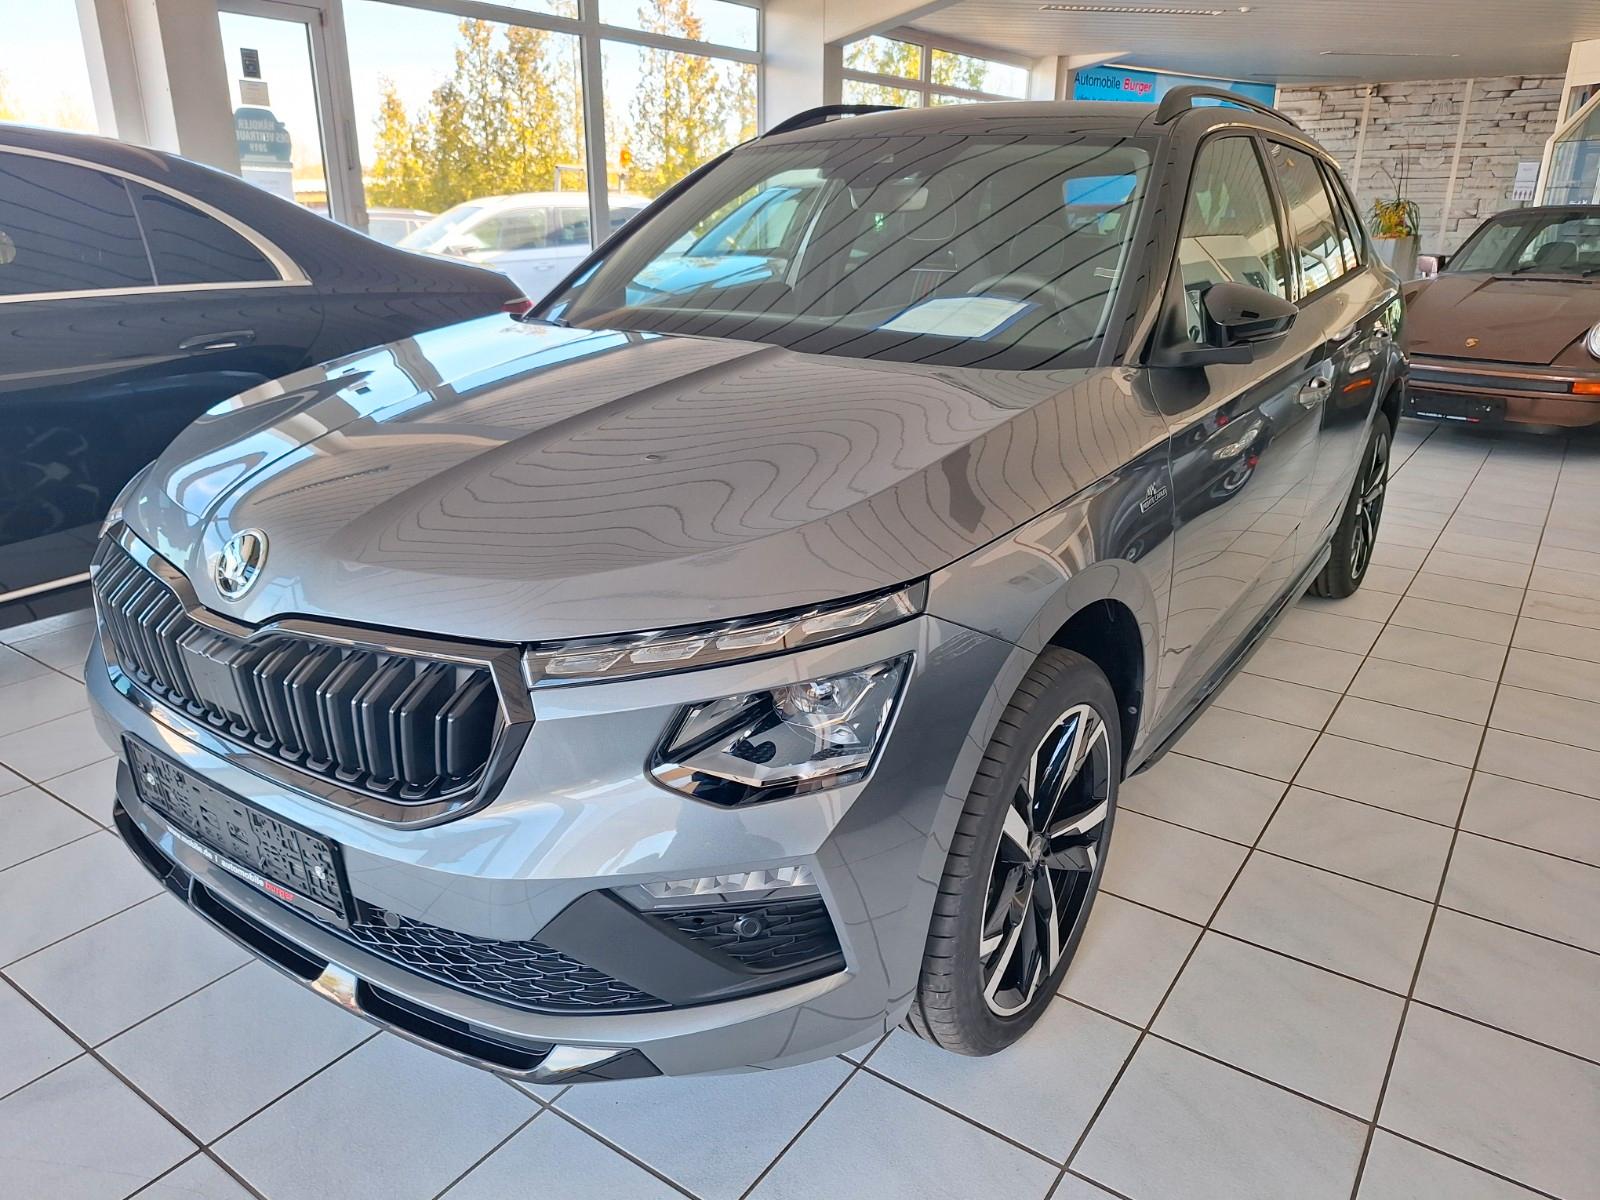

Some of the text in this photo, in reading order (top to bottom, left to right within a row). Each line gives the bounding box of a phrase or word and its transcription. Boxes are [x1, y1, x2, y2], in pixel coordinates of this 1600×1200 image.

[1074, 71, 1152, 95] Automobile Burger
[221, 860, 263, 887] automobile
[263, 880, 294, 901] burger
